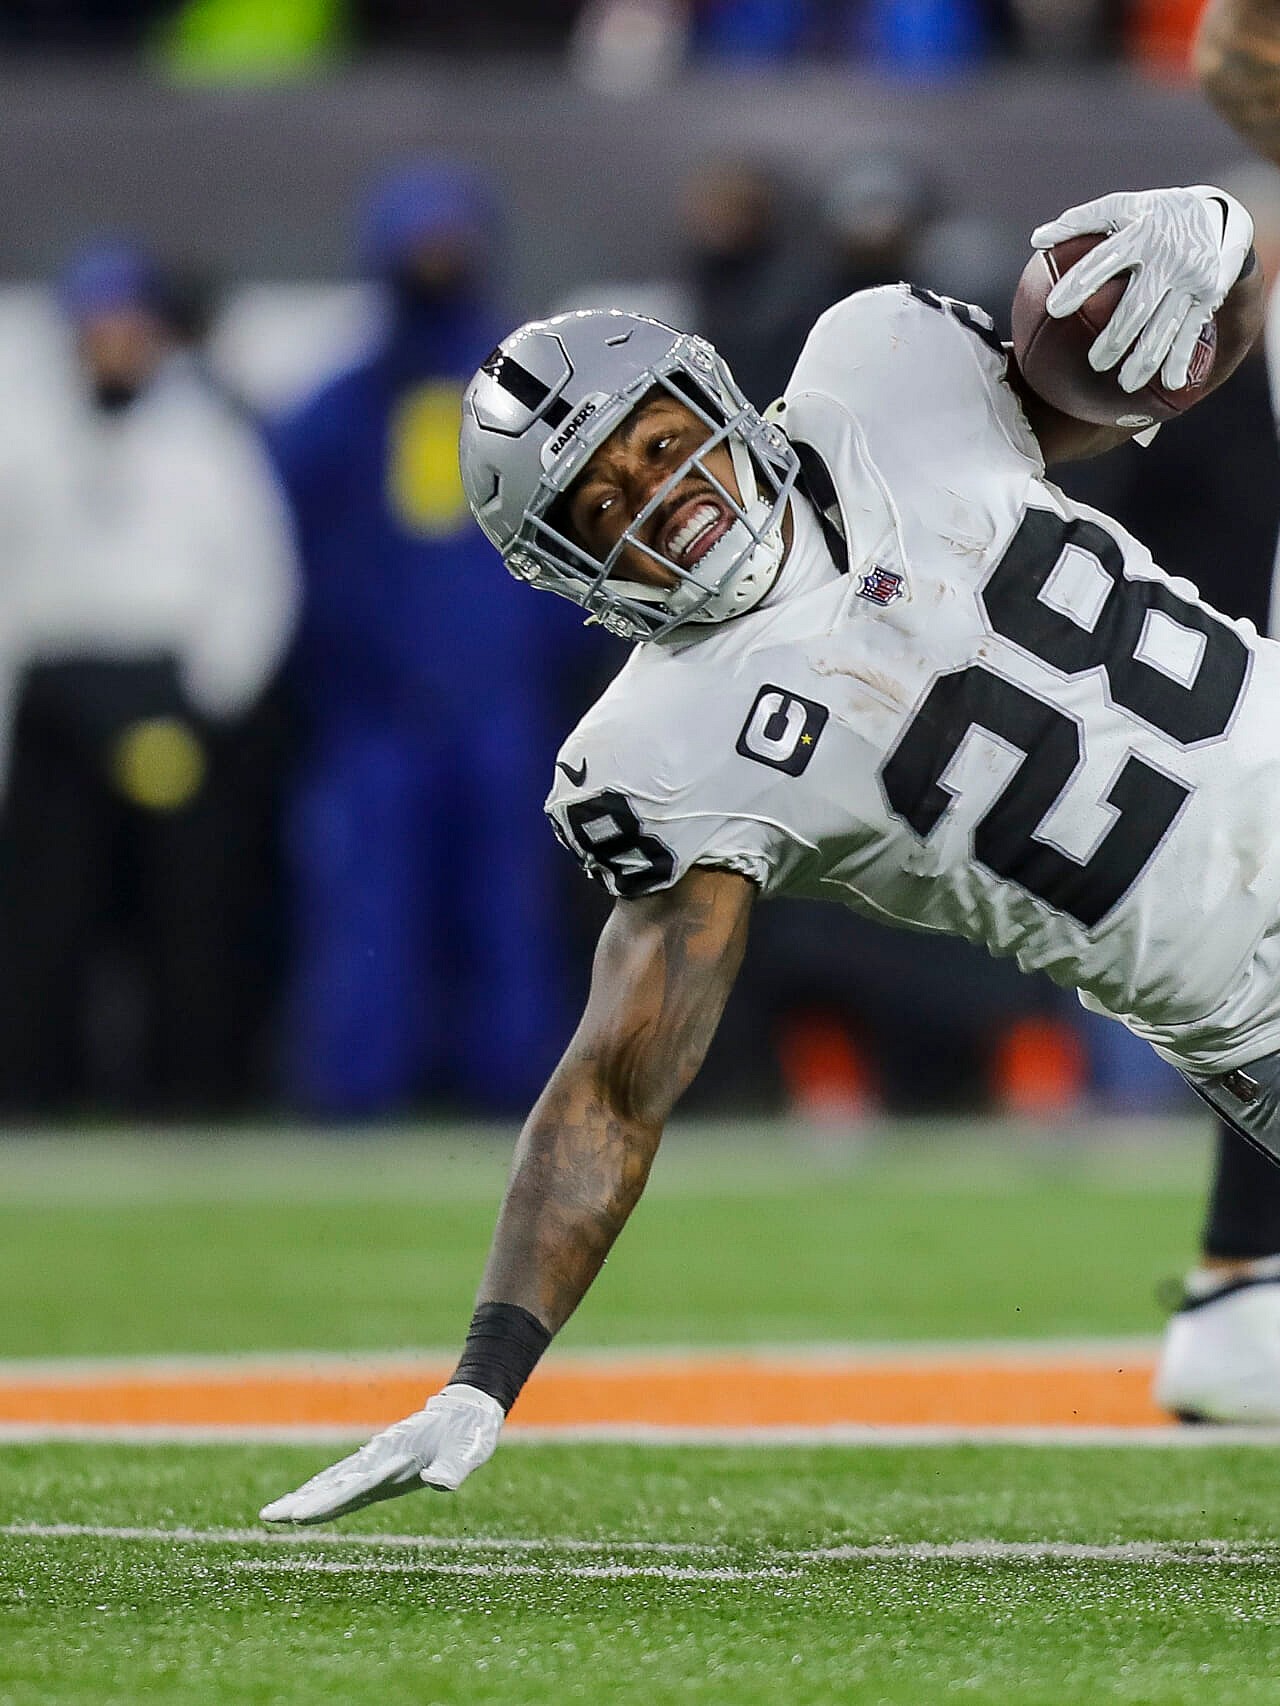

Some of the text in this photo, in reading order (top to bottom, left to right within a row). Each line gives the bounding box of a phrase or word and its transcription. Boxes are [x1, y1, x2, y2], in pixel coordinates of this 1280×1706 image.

[550, 401, 596, 455] RAIDERS
[743, 691, 808, 763] C
[877, 504, 1254, 929] 28
[546, 787, 679, 898] 8
